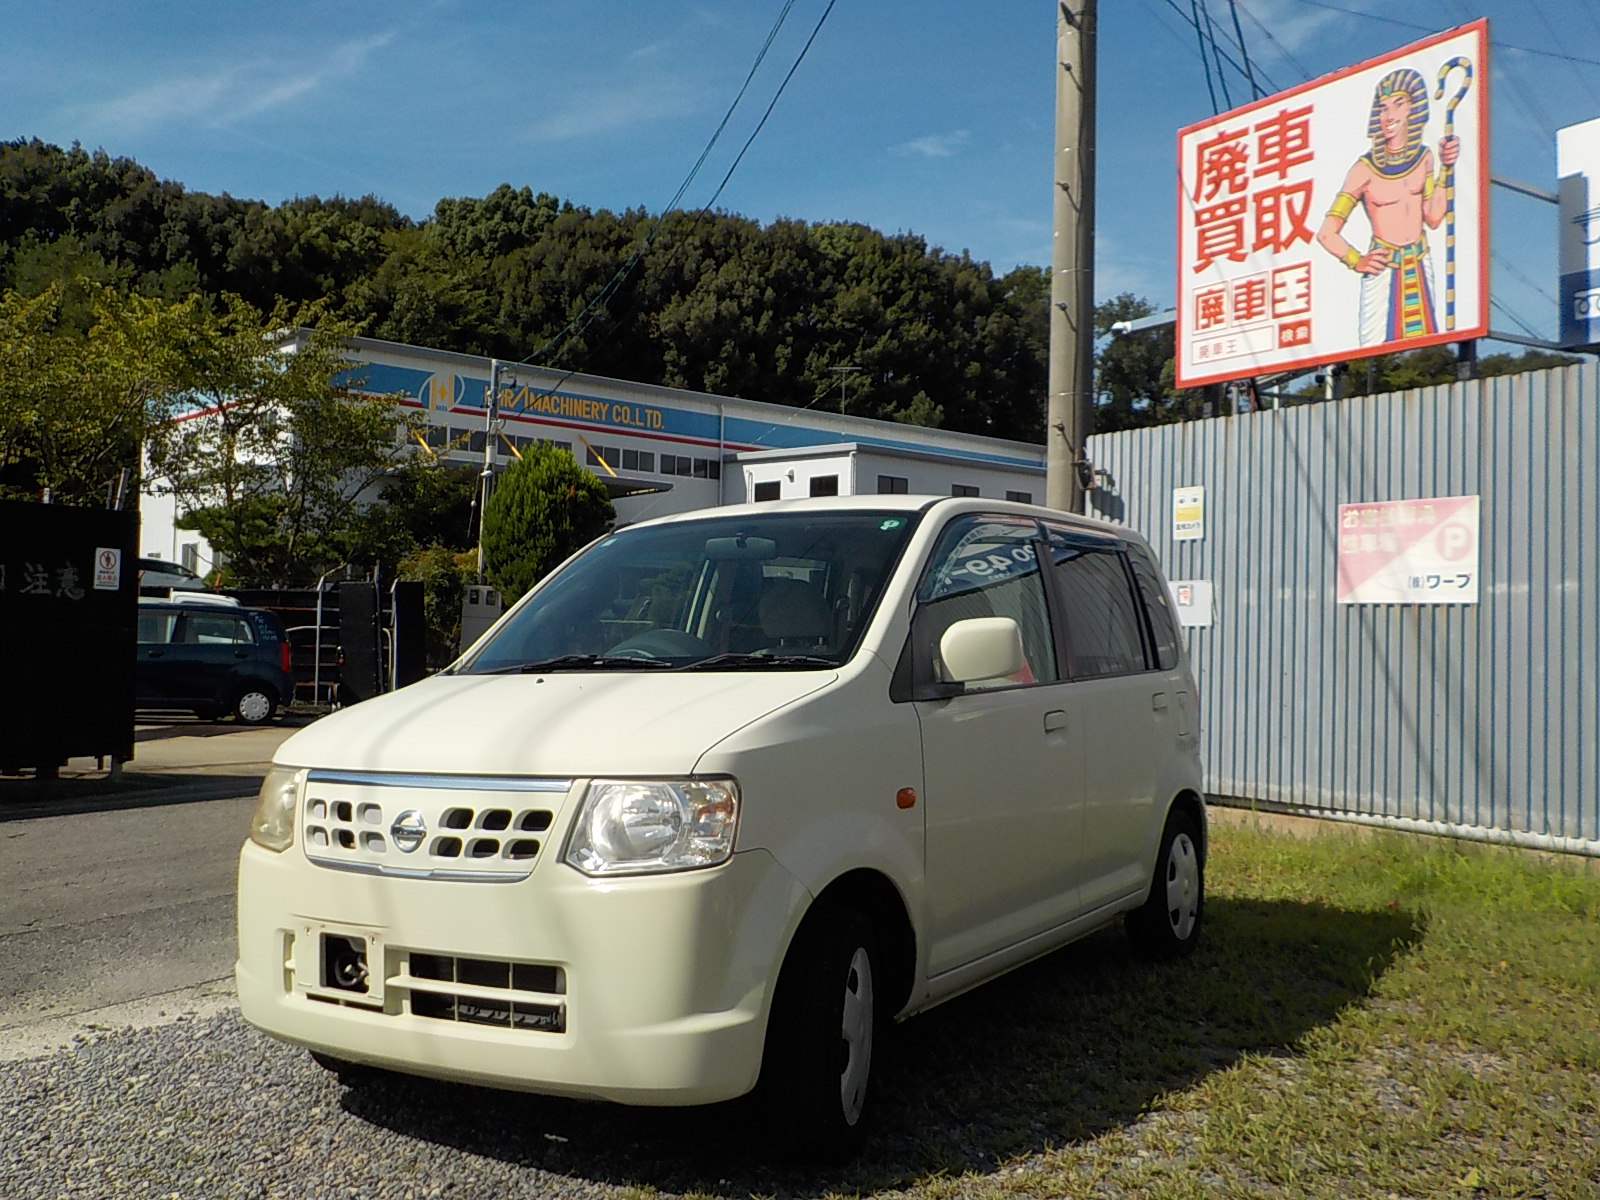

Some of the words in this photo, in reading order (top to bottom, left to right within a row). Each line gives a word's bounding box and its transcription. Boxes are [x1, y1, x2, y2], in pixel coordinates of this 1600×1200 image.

[1193, 104, 1314, 204] 廃車
[1193, 178, 1315, 274] 買取
[529, 390, 610, 422] MACHINERY
